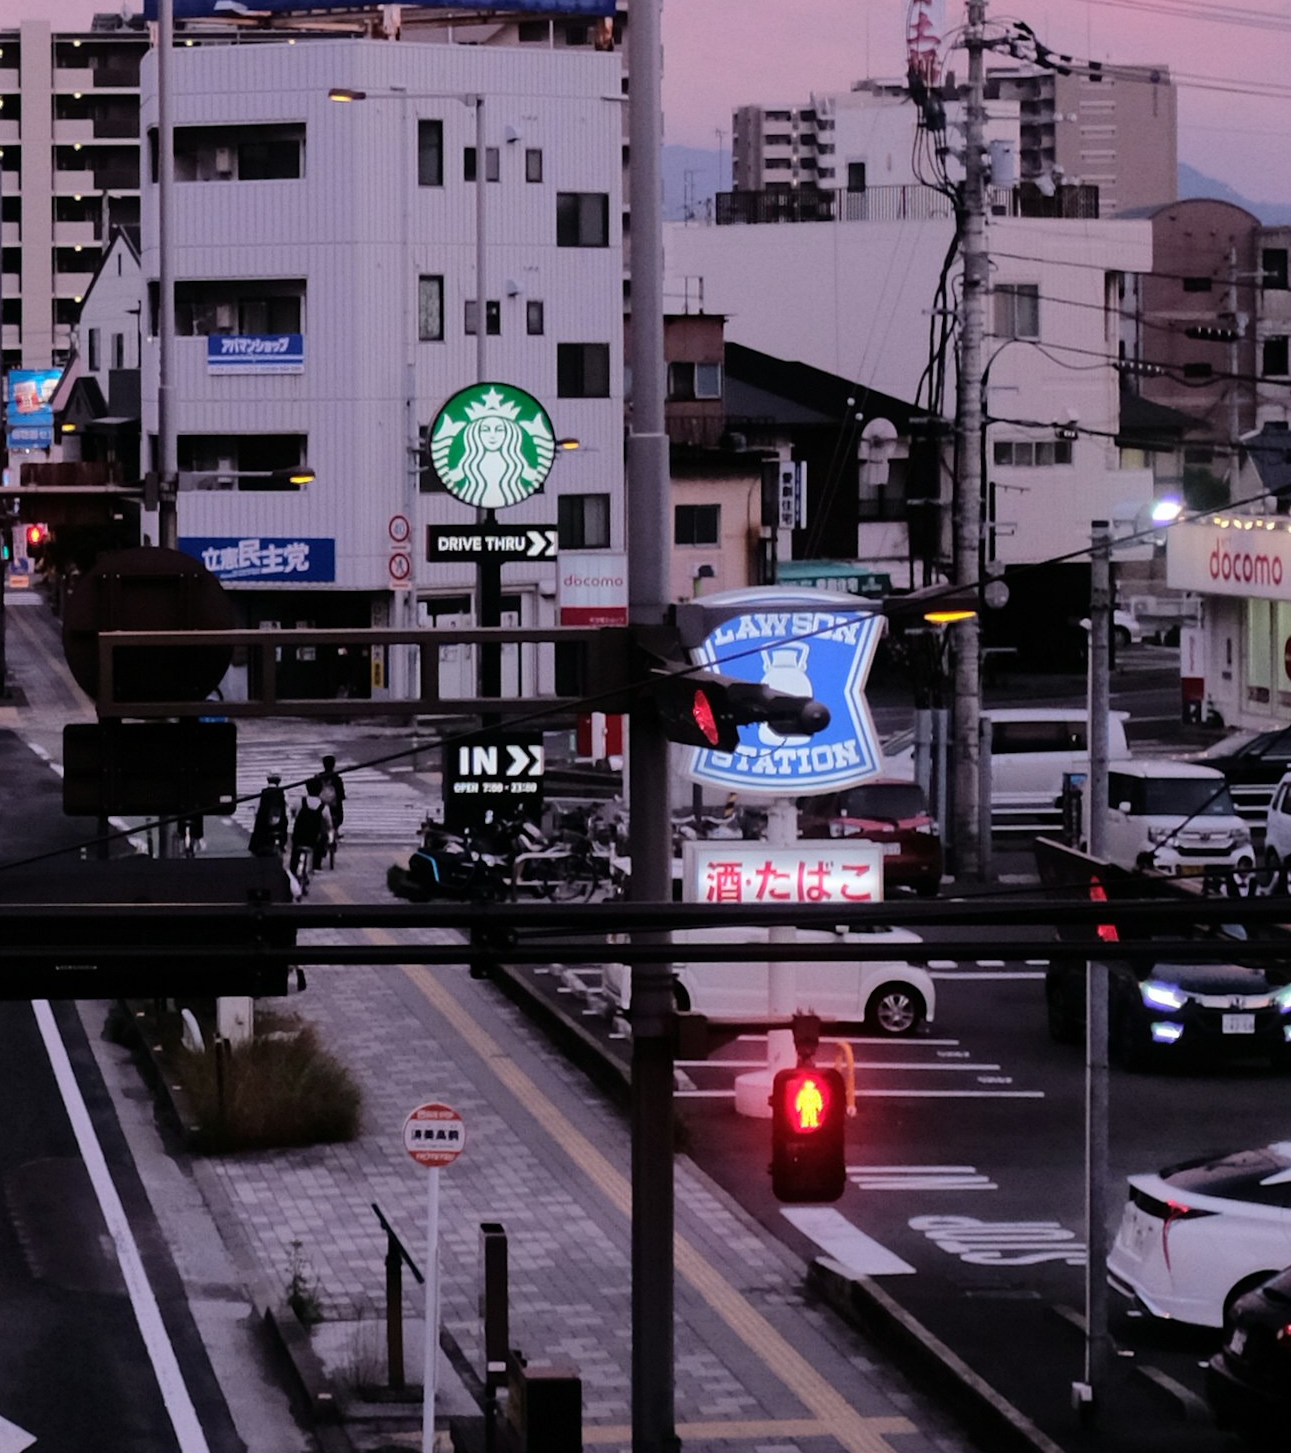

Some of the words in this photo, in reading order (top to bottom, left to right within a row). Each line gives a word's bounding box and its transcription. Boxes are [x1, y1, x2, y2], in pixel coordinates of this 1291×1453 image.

[201, 539, 310, 573] 立憲民主党
[438, 536, 482, 551] DRIVE
[485, 536, 526, 551] THRU
[1209, 538, 1283, 586] docomo
[563, 574, 624, 588] docomo
[715, 612, 861, 646] LAWSON
[459, 746, 498, 776] IN
[711, 739, 860, 776] STATION
